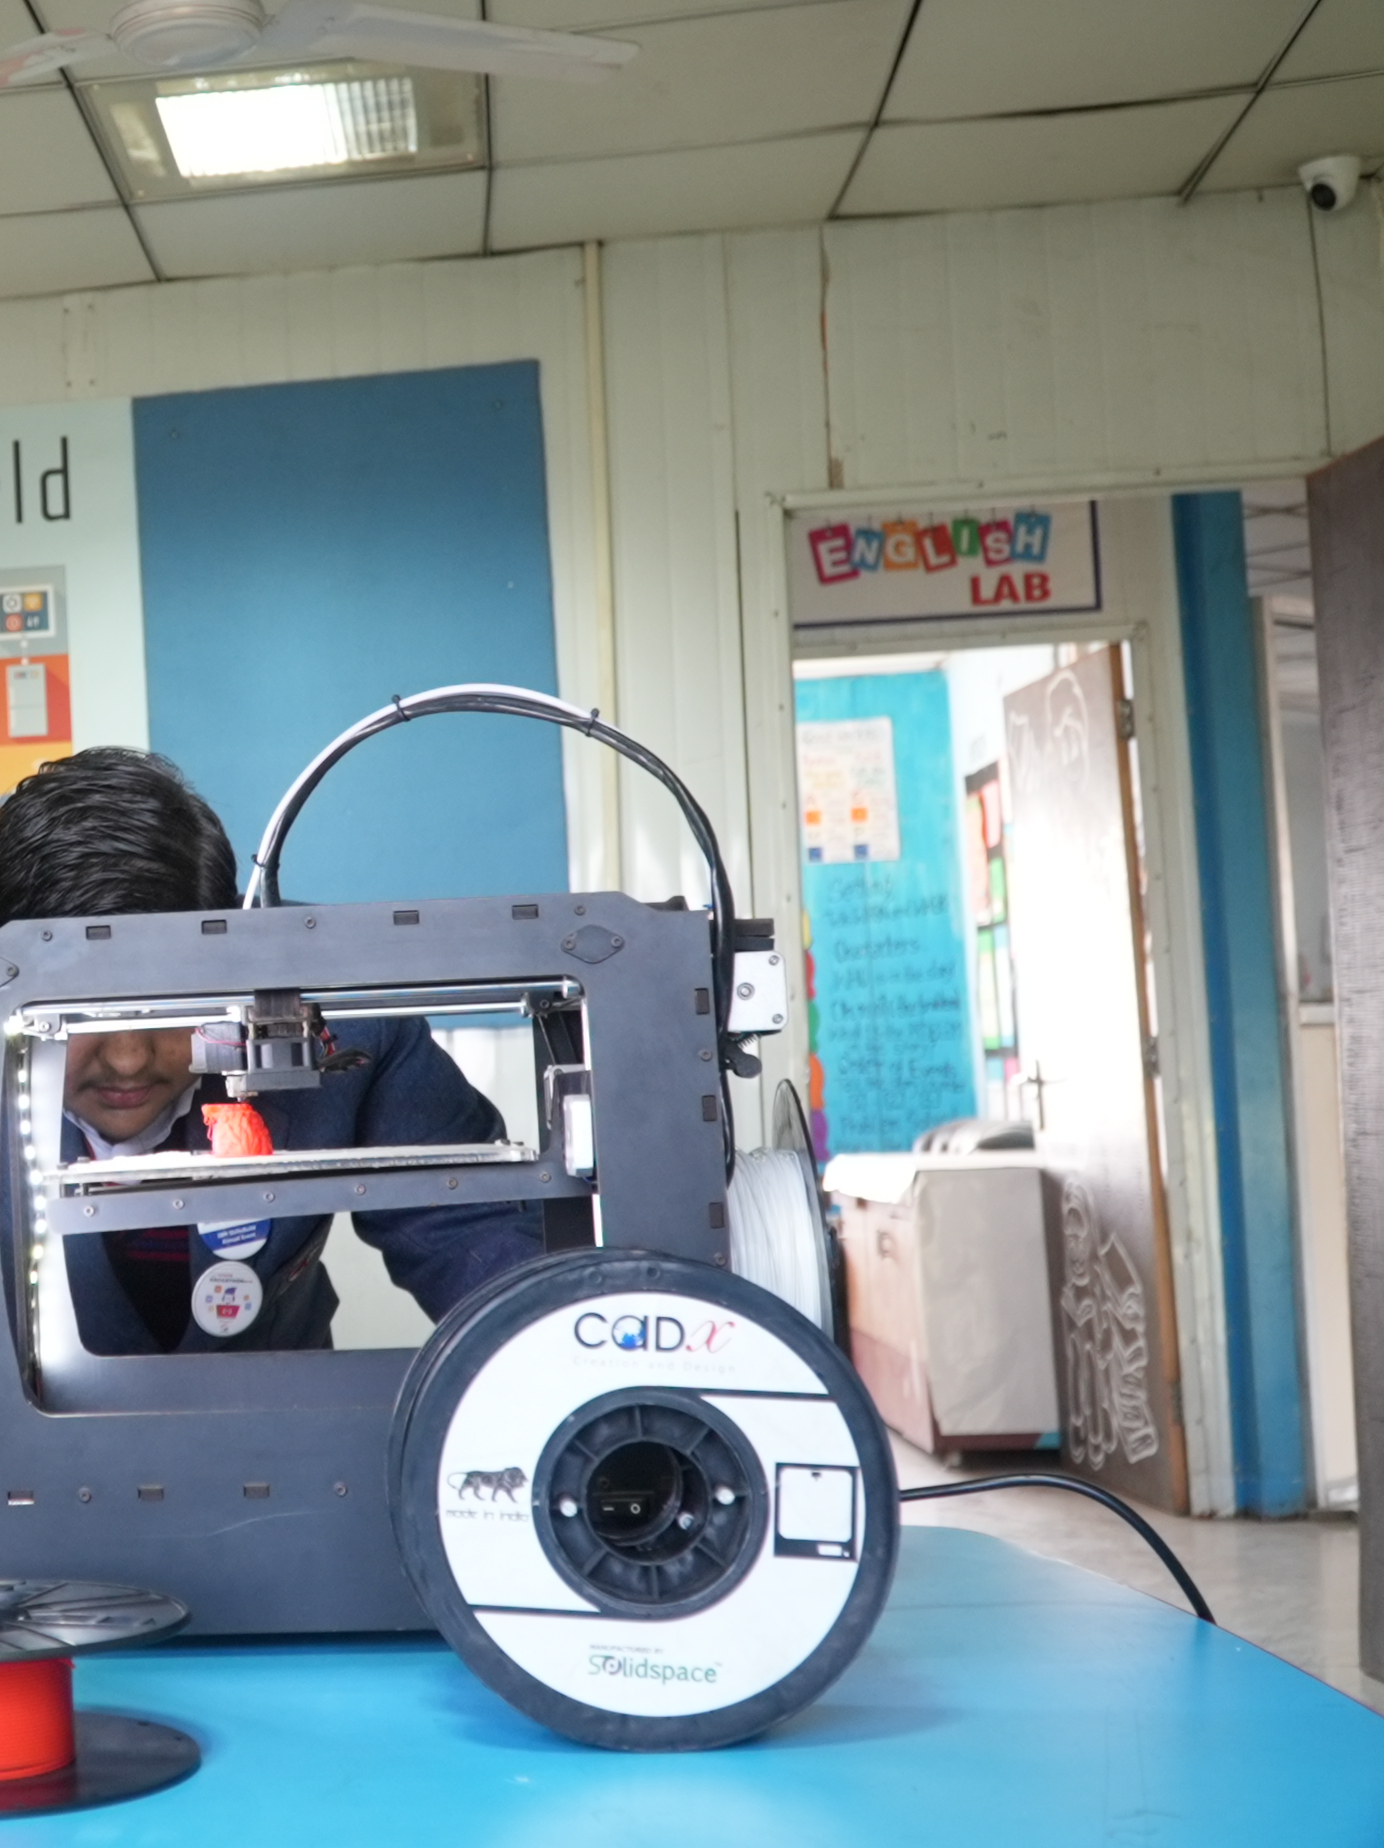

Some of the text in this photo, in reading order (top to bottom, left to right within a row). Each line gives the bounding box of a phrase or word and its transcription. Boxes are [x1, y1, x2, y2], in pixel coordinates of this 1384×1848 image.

[815, 521, 1046, 580] ENGLISH
[970, 571, 1052, 608] LAB
[573, 1356, 737, 1375] Creation and Design
[588, 1654, 717, 1685] Solidspace
